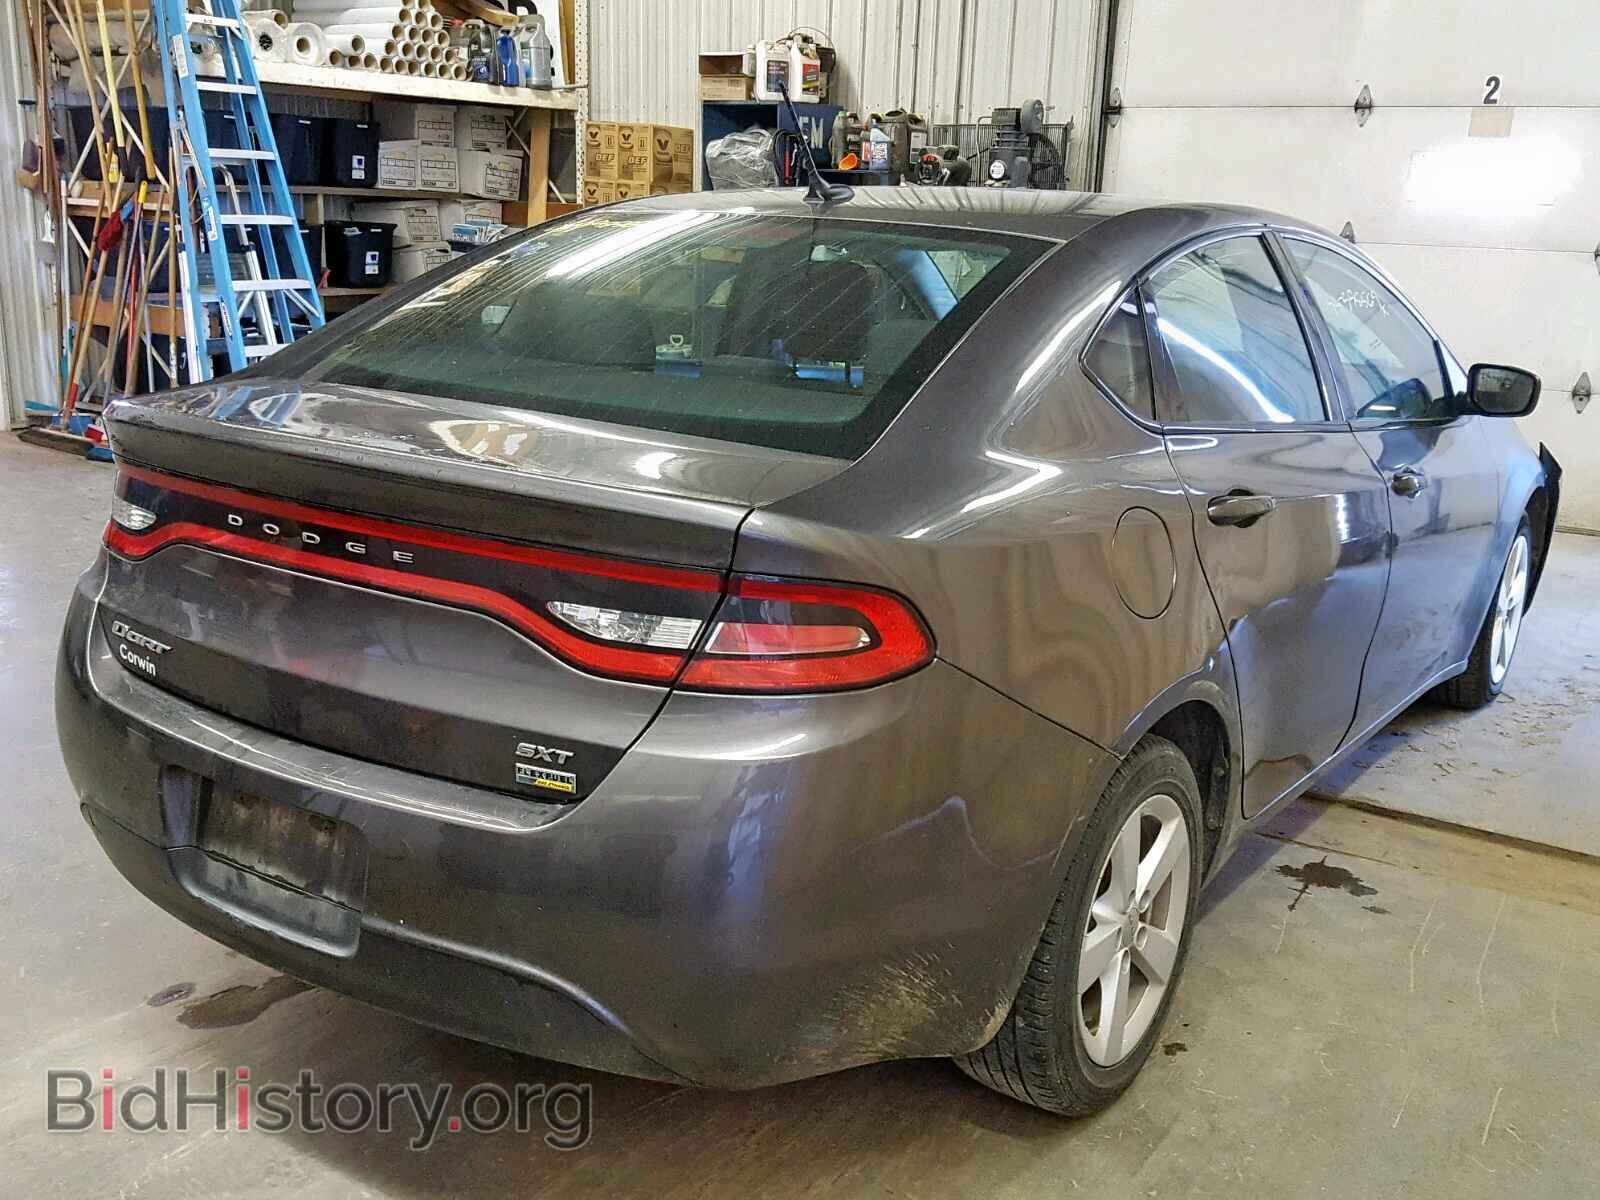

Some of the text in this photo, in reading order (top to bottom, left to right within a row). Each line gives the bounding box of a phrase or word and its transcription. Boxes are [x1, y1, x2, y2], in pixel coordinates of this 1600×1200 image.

[1483, 75, 1500, 104] 2
[227, 513, 415, 564] DODGE
[119, 643, 157, 677] Corwin
[515, 742, 575, 765] SXT
[517, 766, 575, 784] FLEXFUEL
